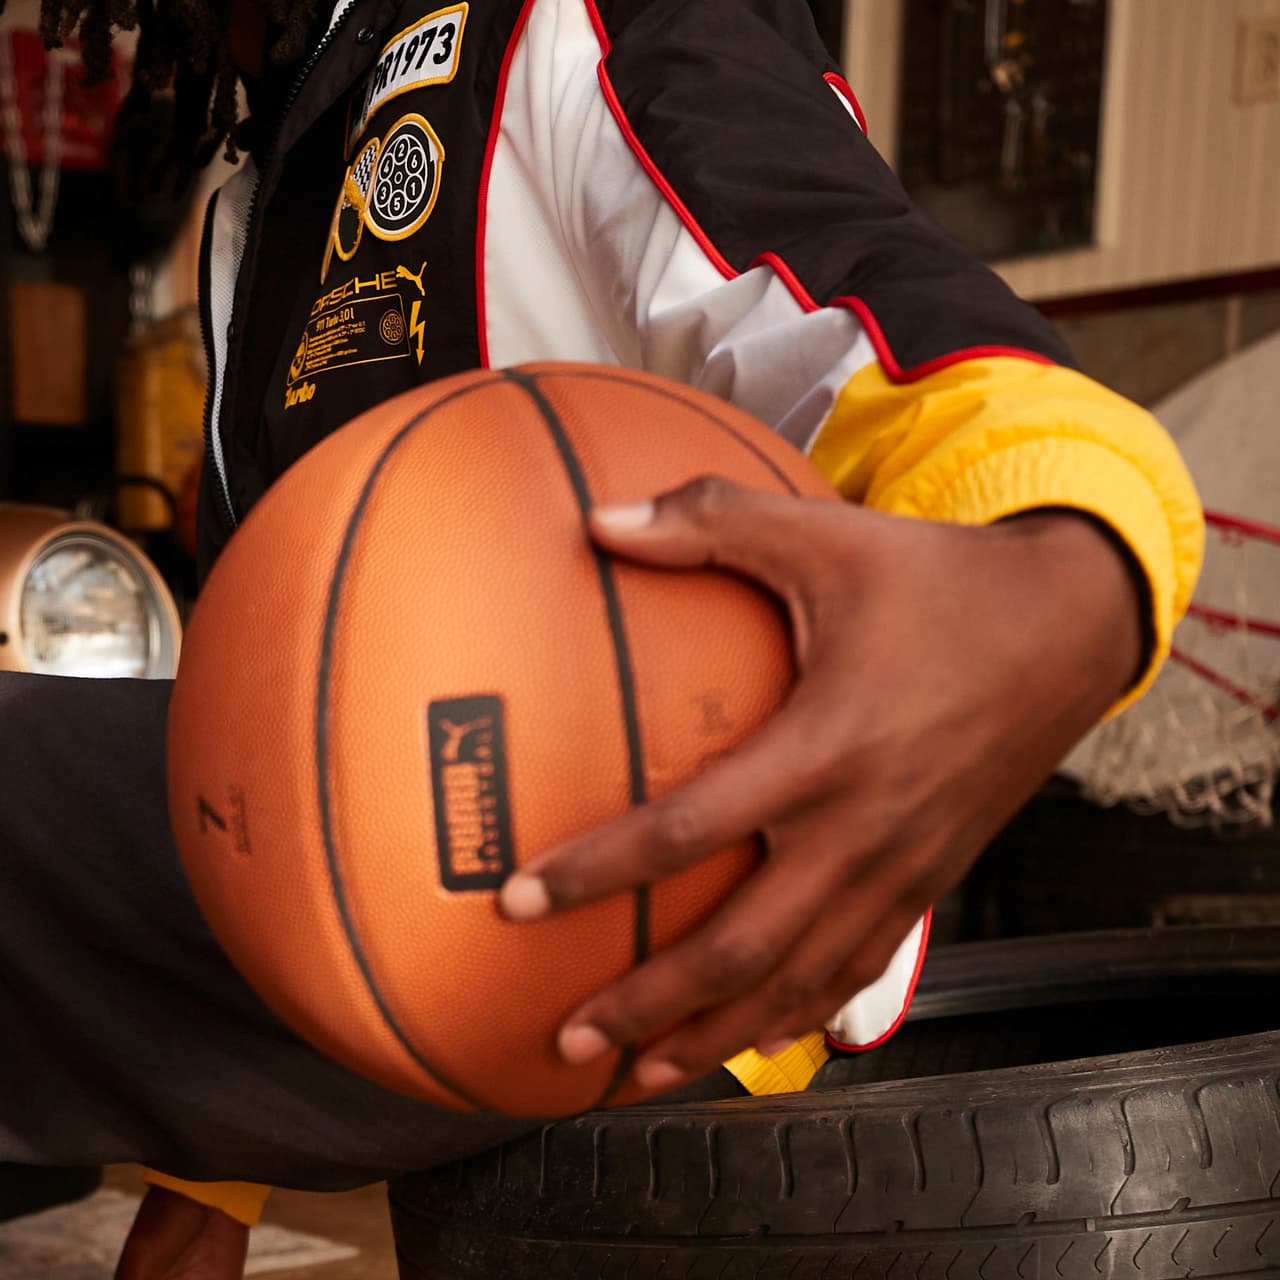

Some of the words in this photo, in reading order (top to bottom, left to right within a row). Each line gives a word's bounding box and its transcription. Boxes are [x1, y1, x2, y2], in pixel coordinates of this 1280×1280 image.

[368, 22, 456, 106] PR1973
[398, 143, 406, 157] 2
[410, 153, 418, 169] 6
[380, 186, 388, 200] 3
[410, 182, 417, 196] 1
[393, 197, 401, 211] 5
[310, 270, 398, 316] ORSCHE
[196, 794, 227, 834] 7
